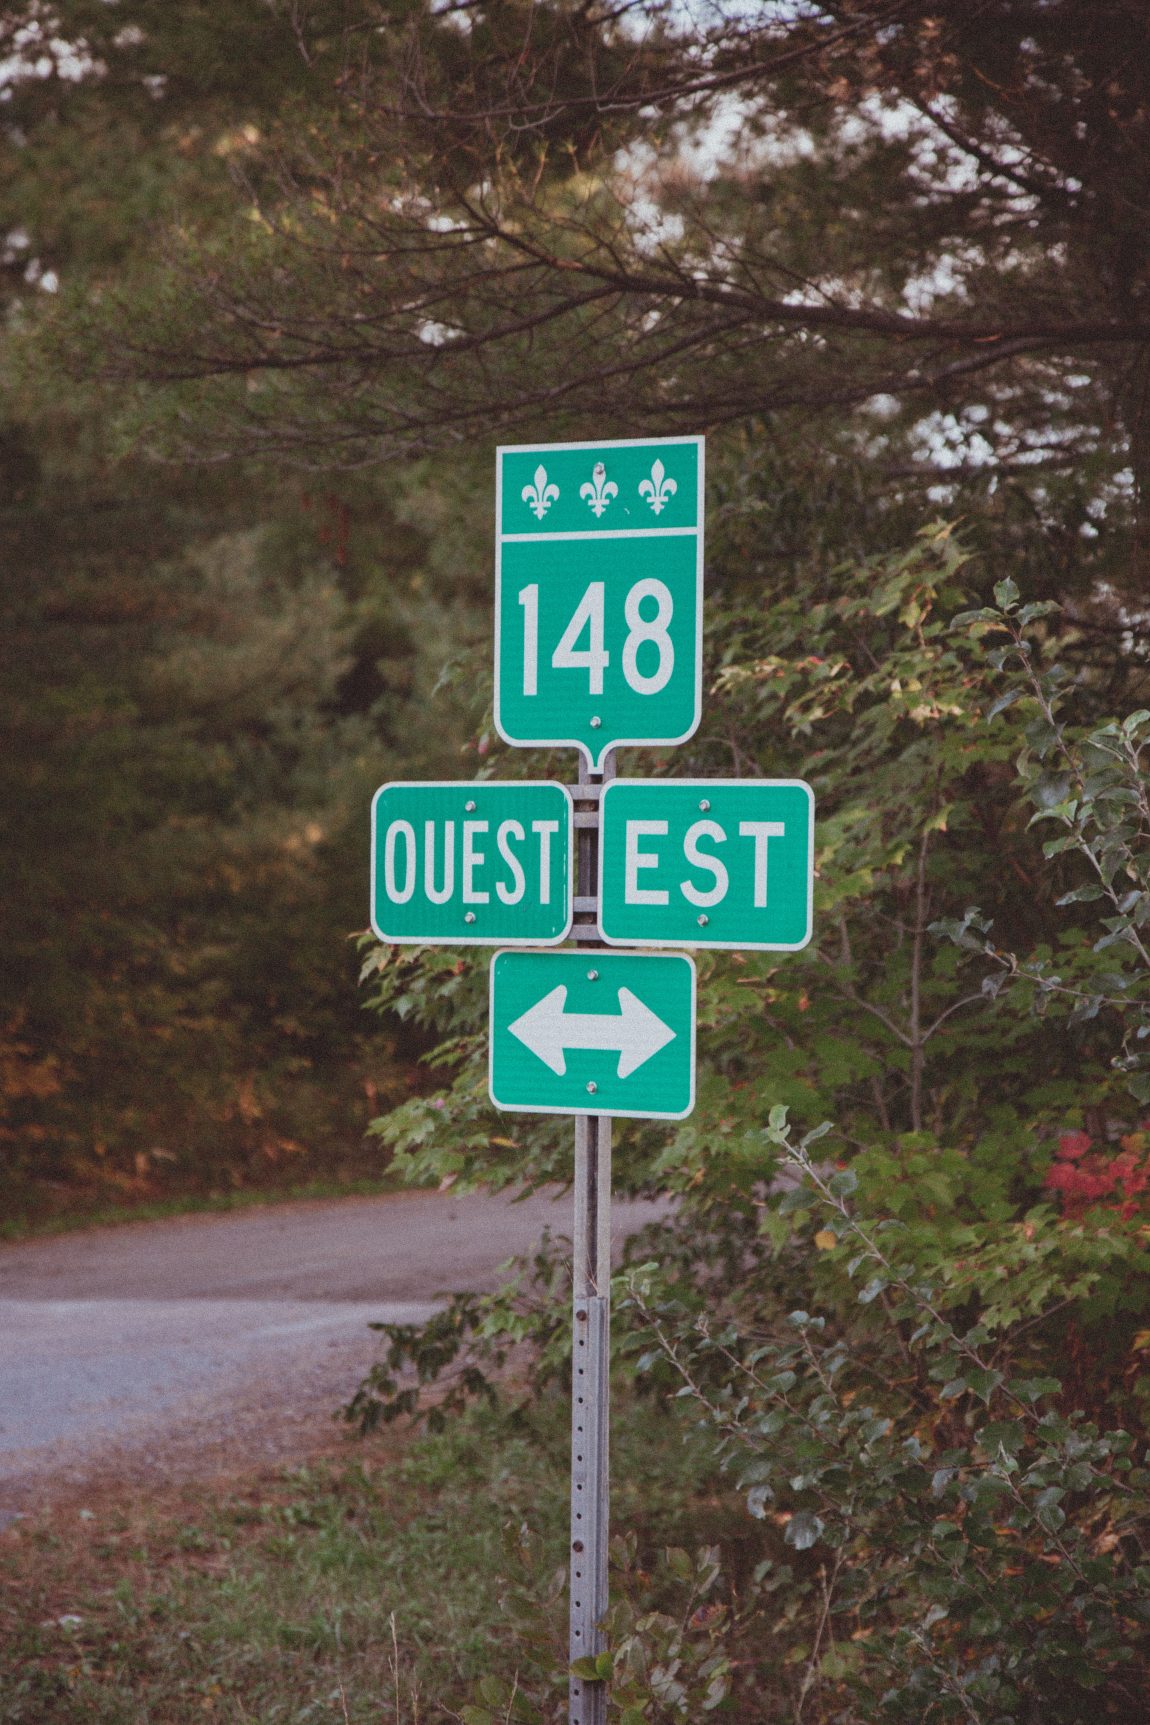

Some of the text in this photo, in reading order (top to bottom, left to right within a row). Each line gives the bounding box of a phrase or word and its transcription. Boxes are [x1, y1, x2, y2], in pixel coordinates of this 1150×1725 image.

[518, 578, 675, 697] 148
[384, 820, 559, 905] OUEST
[625, 819, 785, 908] EST
